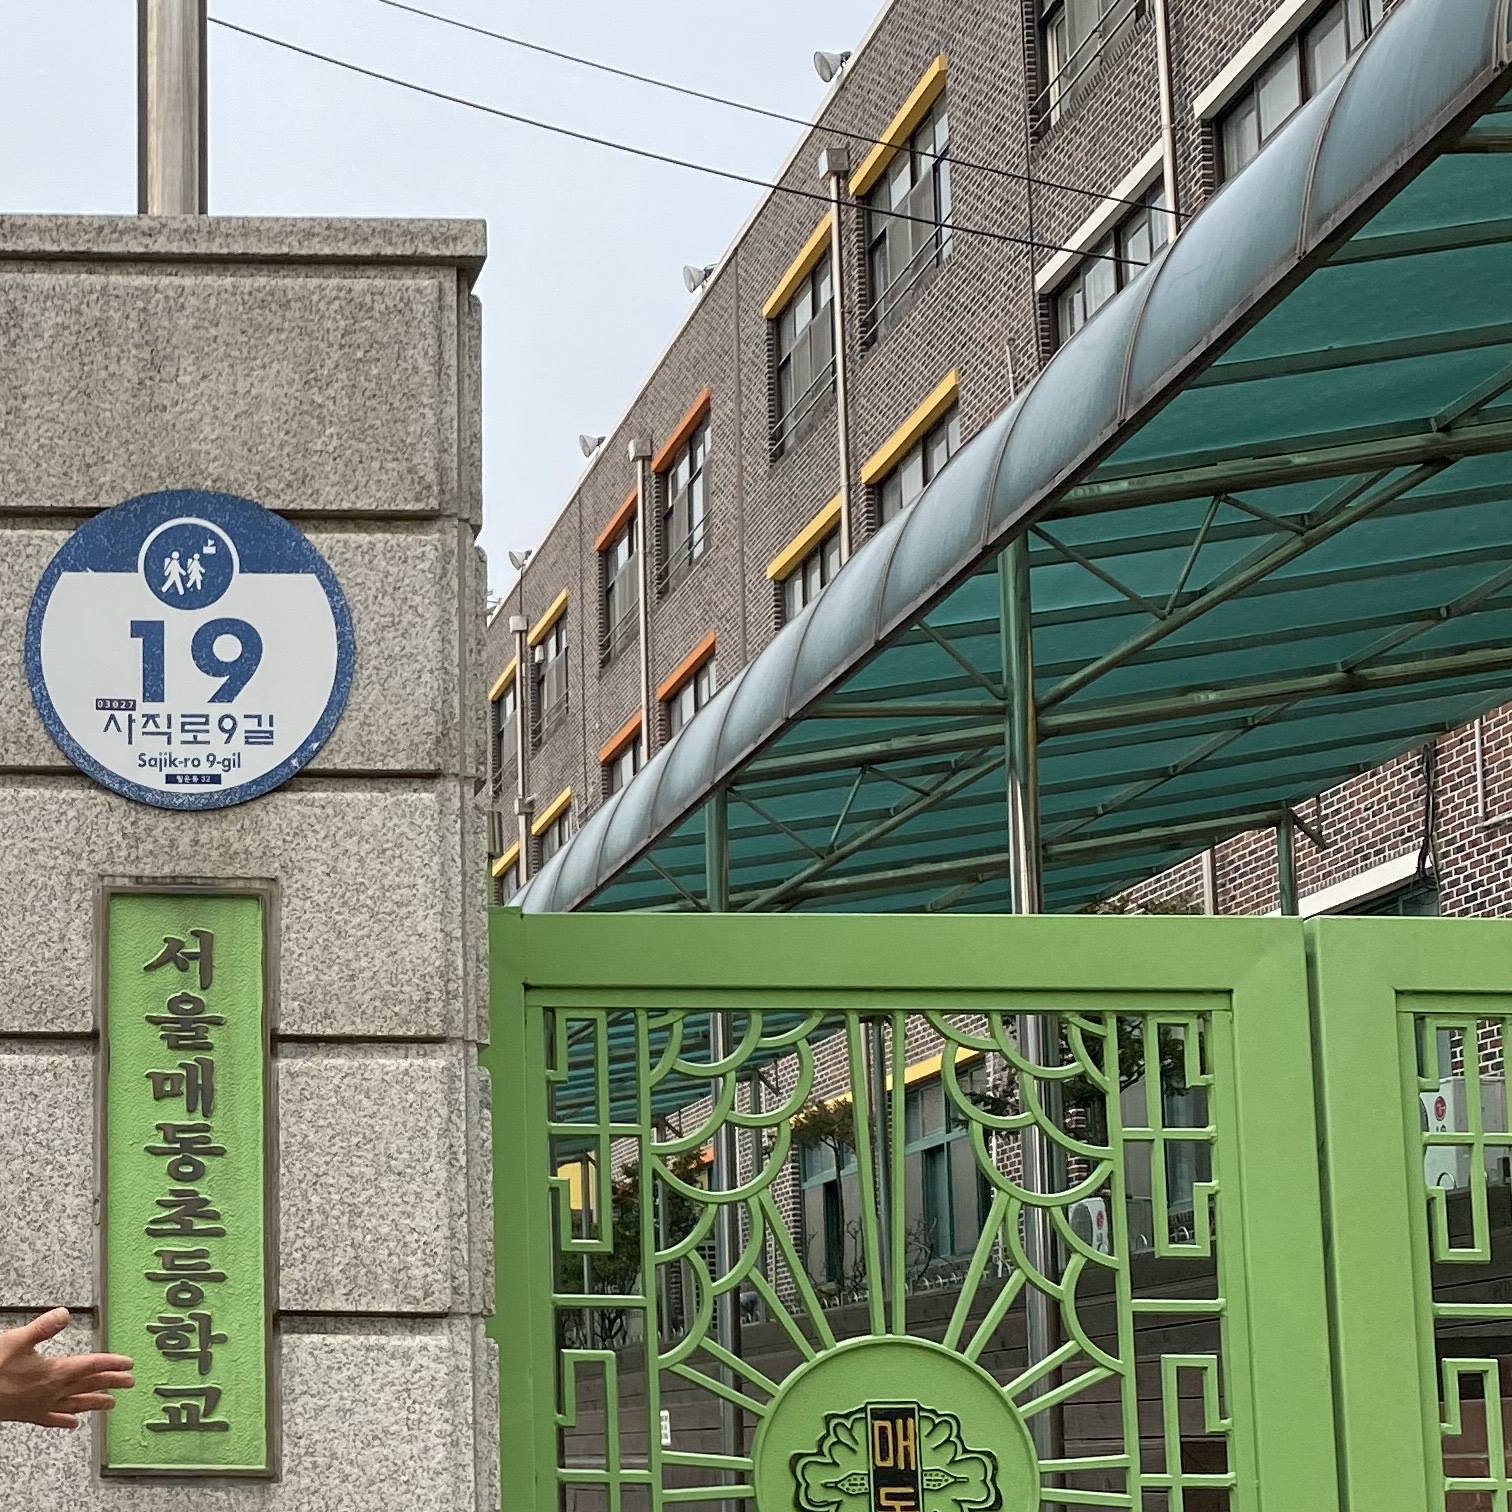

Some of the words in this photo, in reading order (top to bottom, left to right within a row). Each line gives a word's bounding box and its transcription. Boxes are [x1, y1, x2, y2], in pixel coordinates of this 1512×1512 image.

[130, 617, 264, 704] 19
[97, 700, 134, 709] 03027
[103, 713, 274, 746] 사직로9길
[137, 752, 201, 773] Sajik-ro
[206, 752, 241, 773] 9-gil
[142, 928, 230, 1433] 서울매동초등학교
